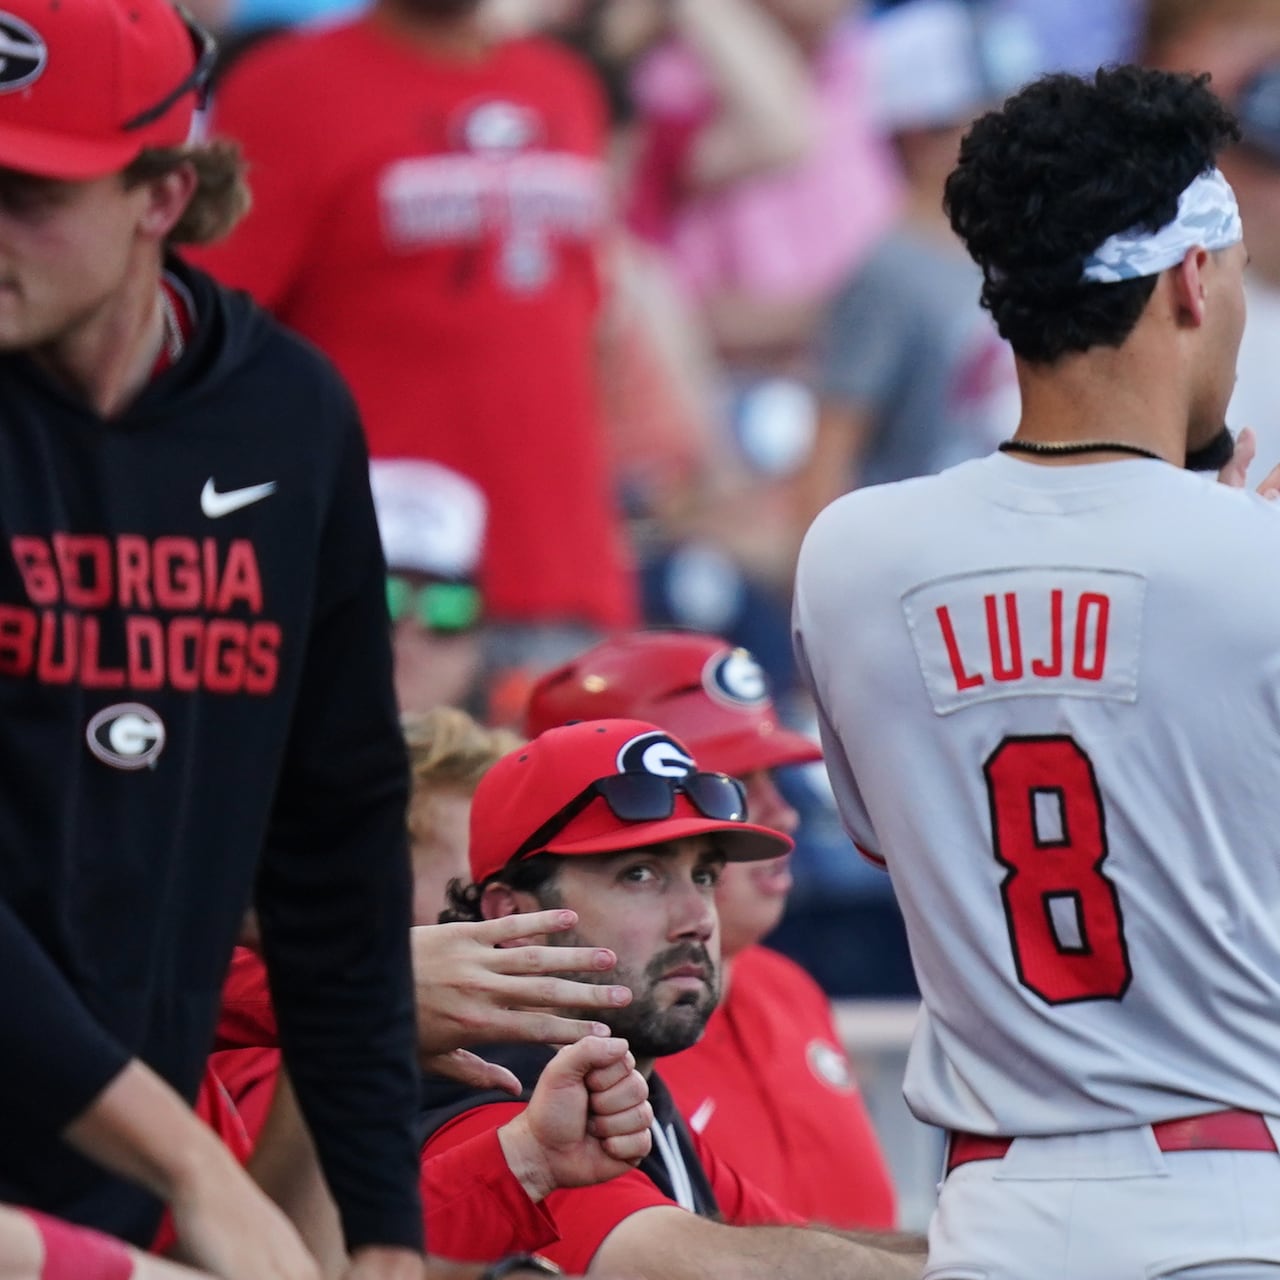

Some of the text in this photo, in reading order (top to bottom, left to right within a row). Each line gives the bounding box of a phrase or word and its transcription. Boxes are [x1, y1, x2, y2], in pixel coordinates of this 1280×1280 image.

[0, 602, 283, 696] BULDOGS
[936, 589, 1111, 692] LUJO
[982, 734, 1134, 1006] 8
